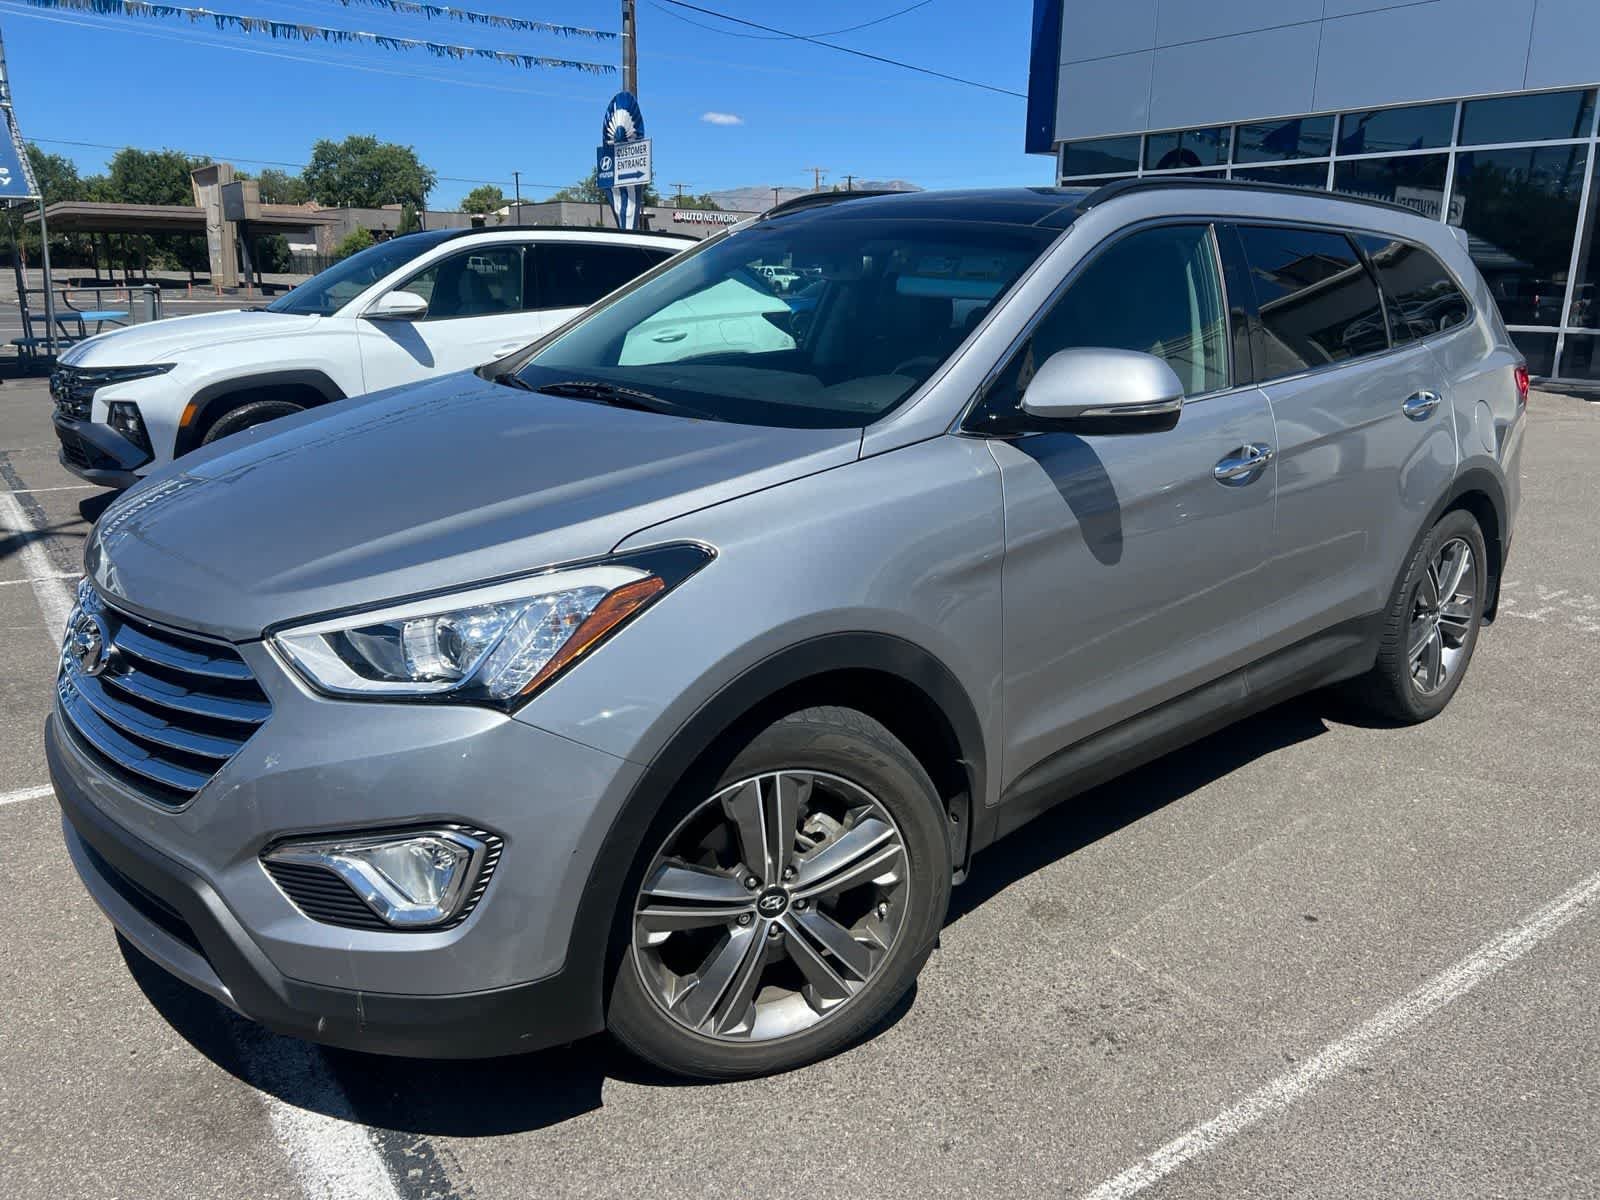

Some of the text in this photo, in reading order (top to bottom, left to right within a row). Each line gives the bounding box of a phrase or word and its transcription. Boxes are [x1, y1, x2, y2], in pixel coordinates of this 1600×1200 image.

[617, 144, 647, 157] CUSTOMER
[617, 157, 647, 170] ENTRANCE
[680, 211, 738, 223] AUTO NETWORK
